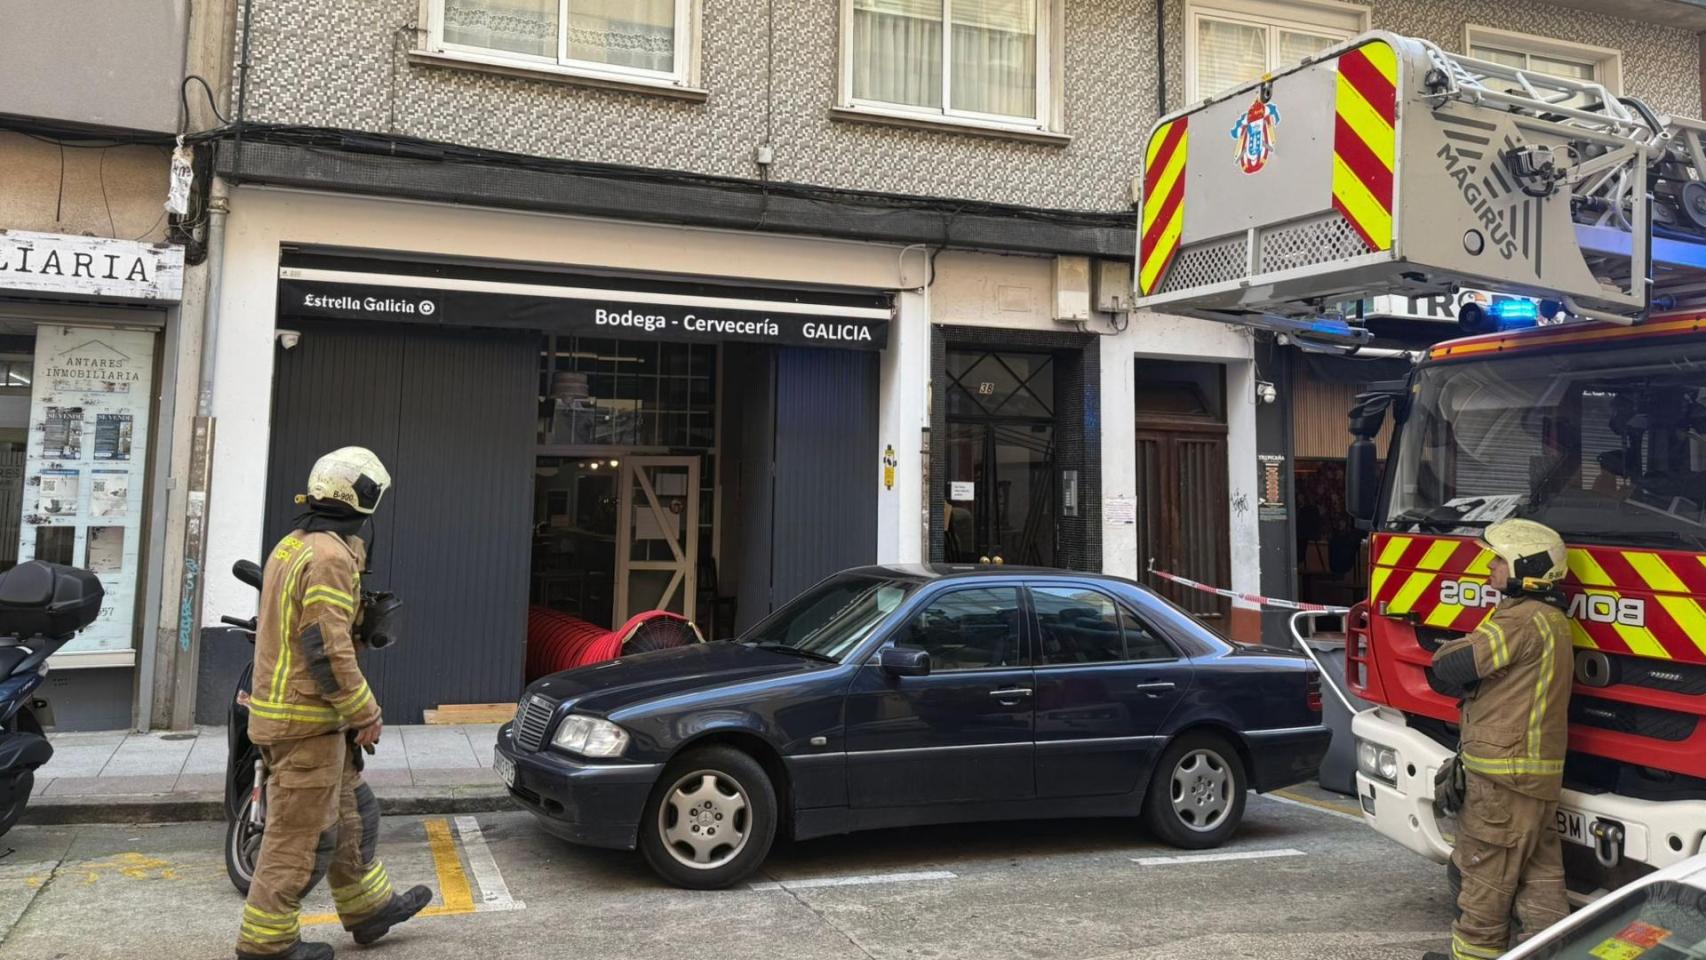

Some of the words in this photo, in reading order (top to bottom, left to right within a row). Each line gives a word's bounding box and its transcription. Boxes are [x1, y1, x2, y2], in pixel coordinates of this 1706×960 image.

[1437, 143, 1518, 260] MAGIRUS
[304, 294, 361, 310] Estrella
[364, 297, 415, 313] Galicia
[595, 309, 666, 331] Bodega
[683, 315, 779, 336] Cervecería
[802, 322, 872, 341] GALICIA
[46, 368, 139, 380] INMOBILIARIA
[66, 357, 122, 368] ANTARES
[1547, 811, 1581, 839] BM
